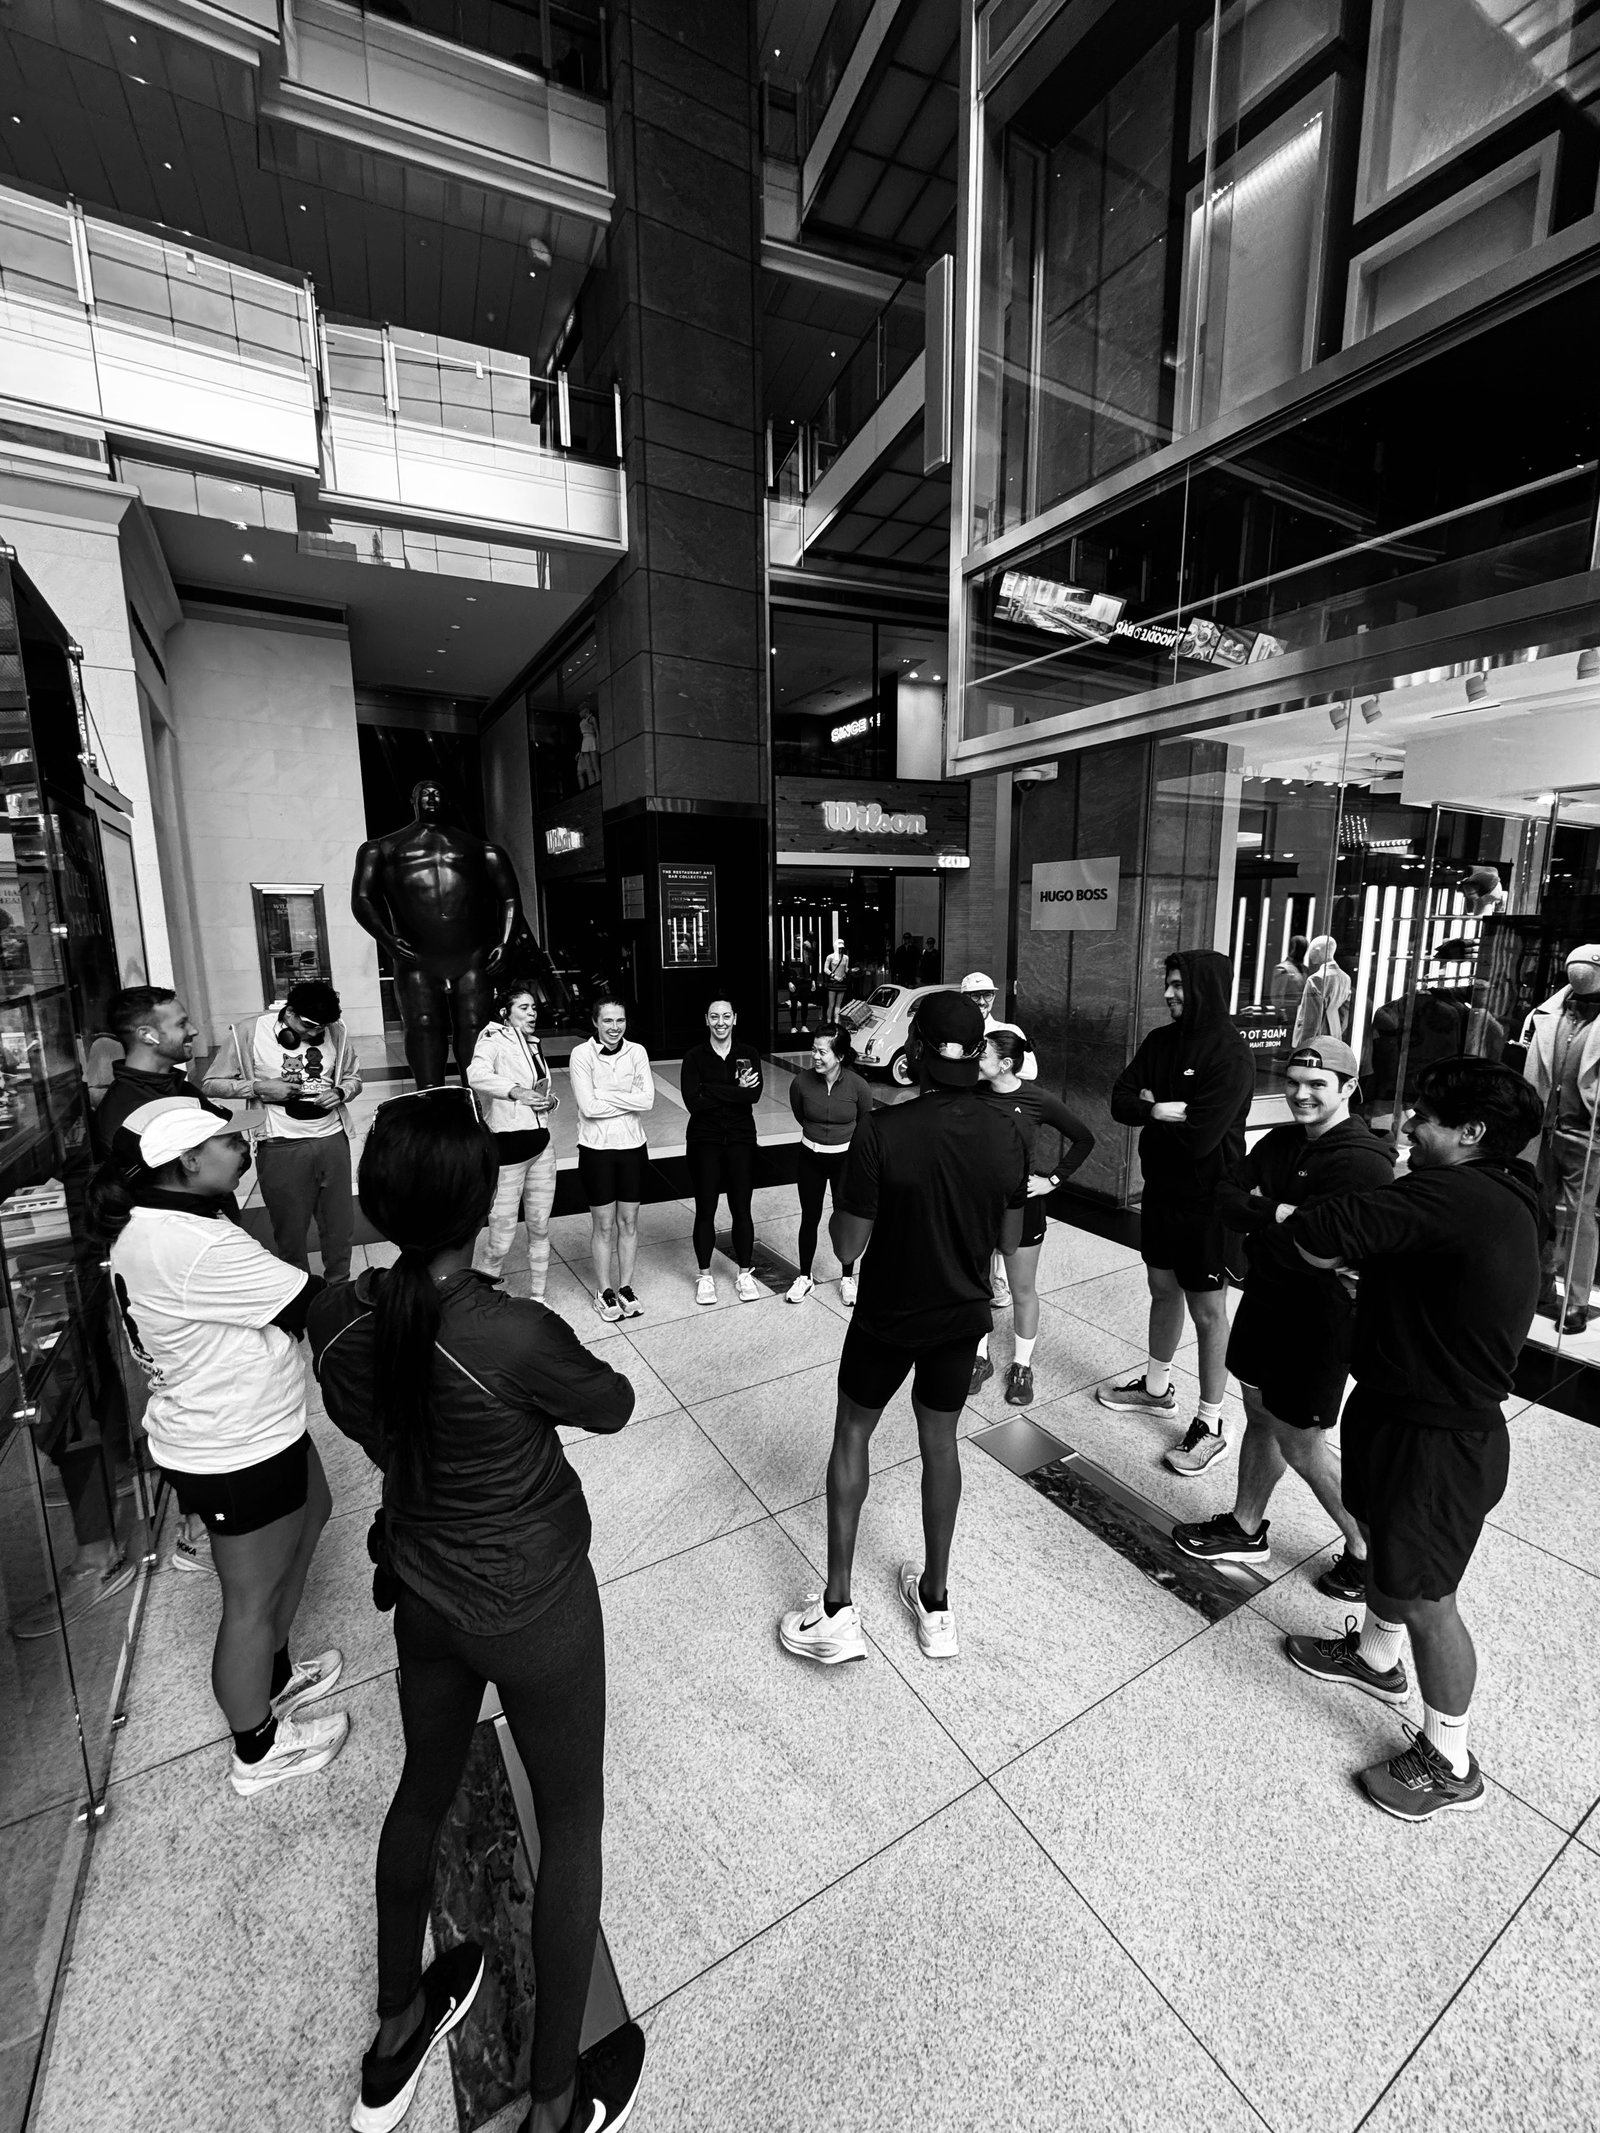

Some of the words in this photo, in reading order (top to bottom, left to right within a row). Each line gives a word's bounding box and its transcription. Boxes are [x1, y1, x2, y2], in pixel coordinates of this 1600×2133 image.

[831, 717, 867, 742] SINCE
[821, 800, 928, 835] Wilson
[1040, 889, 1074, 902] HUGO
[1076, 887, 1108, 901] BOSS
[176, 1539, 197, 1557] HOKA
